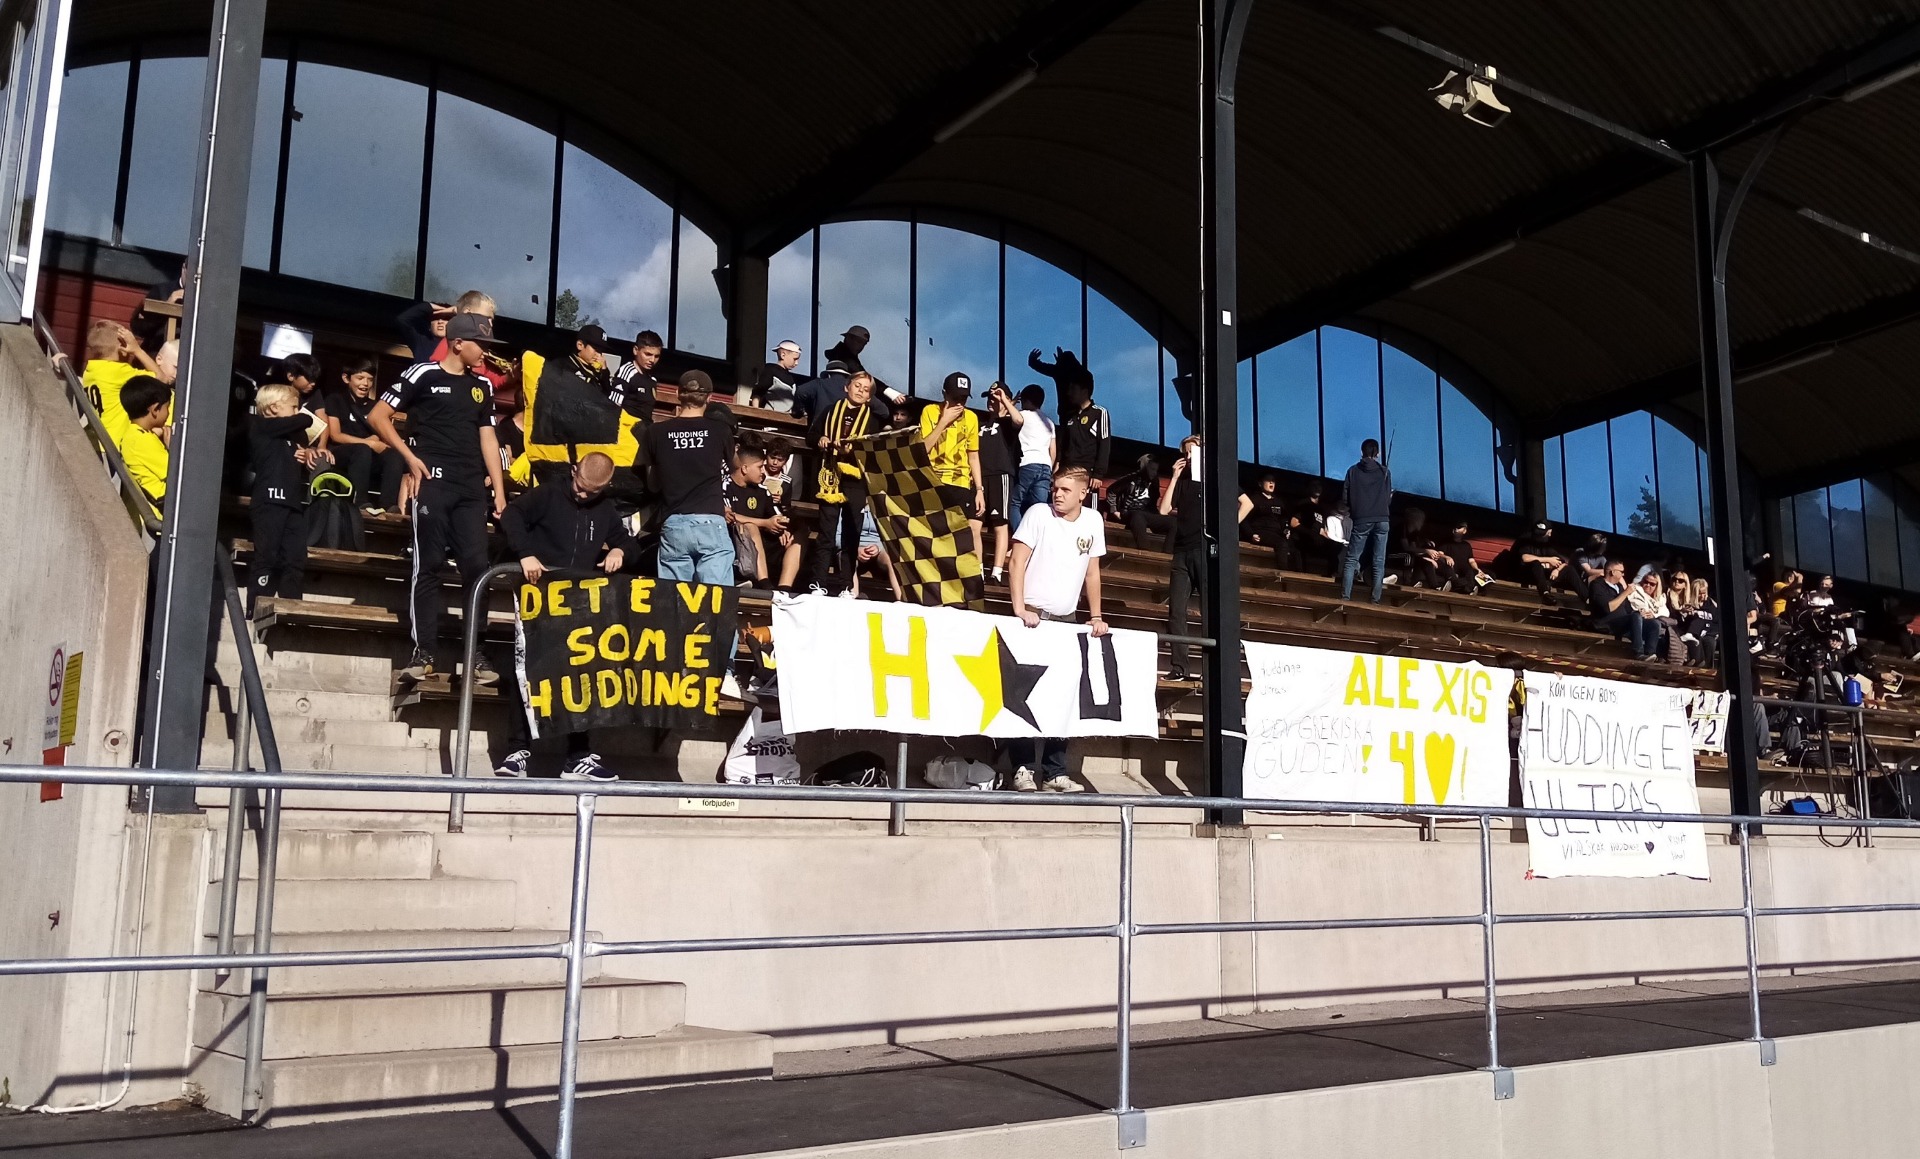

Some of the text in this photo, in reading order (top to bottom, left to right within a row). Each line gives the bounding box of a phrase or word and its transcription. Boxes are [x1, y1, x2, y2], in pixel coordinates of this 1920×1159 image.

[668, 430, 709, 439] HUDDINGE
[673, 437, 704, 449] 1912
[267, 487, 286, 500] TLL
[520, 578, 723, 620] DET E VI
[567, 624, 667, 666] SOM
[684, 622, 712, 668] É
[866, 612, 1122, 721] H U
[526, 668, 722, 718] HUDDINGE
[1549, 680, 1566, 698] KOM
[1569, 684, 1595, 701] IGEN
[1298, 715, 1373, 741] GREKISKA
[1526, 701, 1681, 770] HUDDINGE
[1529, 779, 1664, 836] ULTRAS
[1562, 844, 1573, 860] VI
